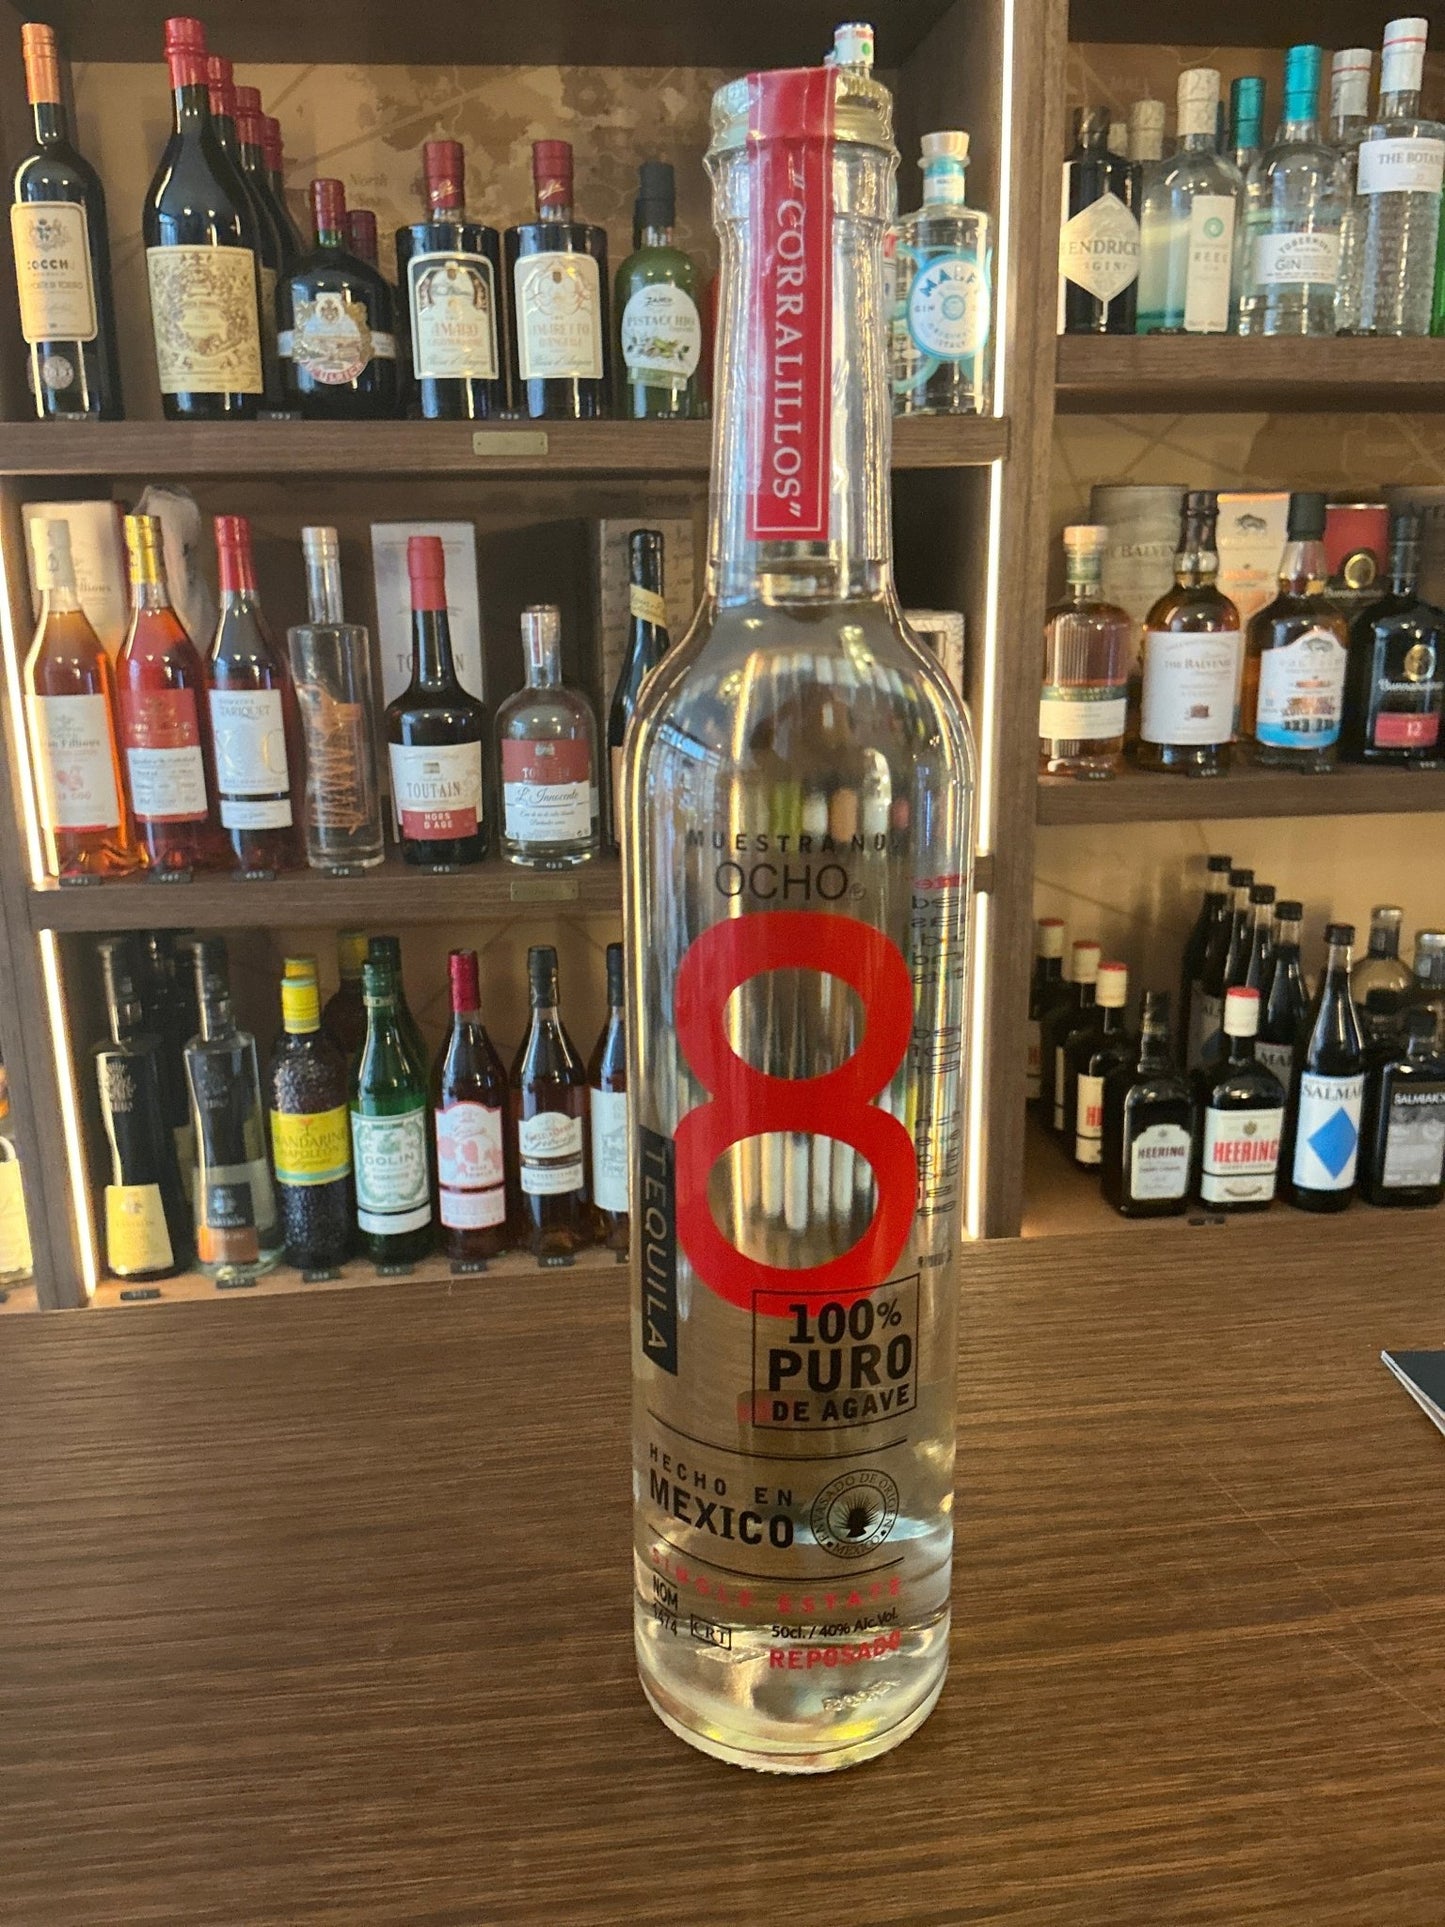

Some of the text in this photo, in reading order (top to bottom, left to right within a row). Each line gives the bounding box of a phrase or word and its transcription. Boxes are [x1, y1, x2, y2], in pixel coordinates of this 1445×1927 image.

[1379, 152, 1403, 165] THE
[1092, 261, 1122, 272] GIN
[1275, 257, 1301, 271] GIN
[919, 265, 979, 298] MALF
[913, 305, 936, 313] GIN
[1184, 658, 1232, 669] BALVENIE
[219, 705, 270, 720] TARIQUET
[1406, 721, 1422, 737] 12
[406, 781, 461, 800] TOUTAIN
[424, 812, 451, 821] HORS
[684, 829, 835, 853] MUESTRA
[364, 1151, 415, 1166] DOLIN
[1137, 1146, 1185, 1159] HEERING
[1213, 1138, 1279, 1163] HEERING
[644, 1147, 668, 1349] TEQUILA
[788, 1297, 903, 1344] 100%
[768, 1333, 913, 1393] PURO
[771, 1383, 910, 1422] DE AGAVE
[649, 1442, 793, 1507] HECHO EN
[650, 1467, 795, 1549] MEXICO
[814, 1475, 856, 1542] ENVASADO
[651, 1546, 901, 1616] SINGLE ESTATE
[652, 1574, 679, 1612] NOM
[693, 1621, 726, 1645] CRT
[771, 1625, 806, 1639] 50cl.
[820, 1623, 851, 1638] 40%
[768, 1628, 903, 1670] REPOSADO
